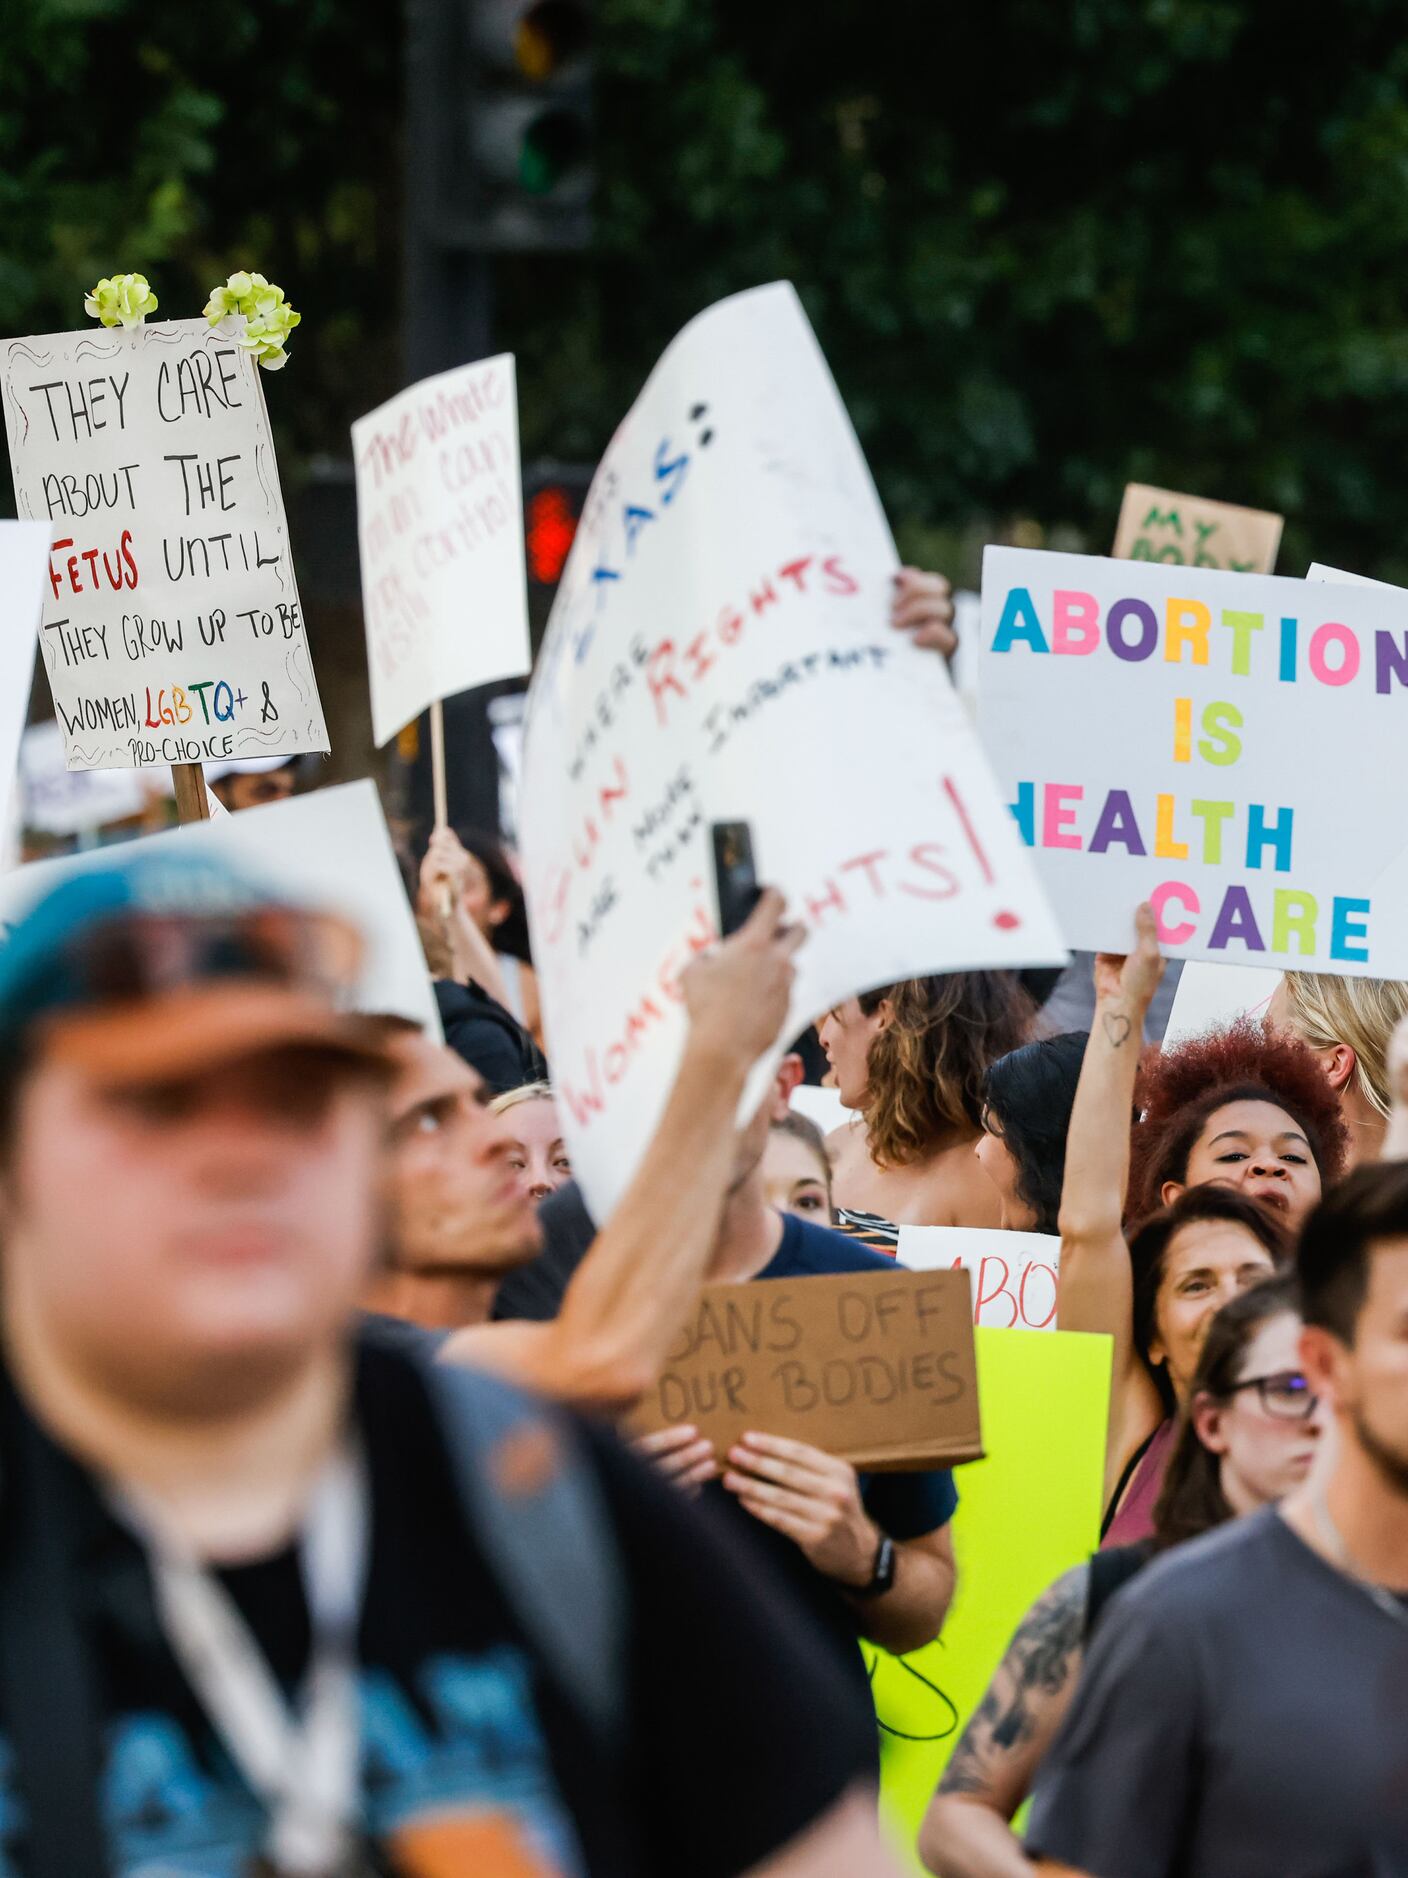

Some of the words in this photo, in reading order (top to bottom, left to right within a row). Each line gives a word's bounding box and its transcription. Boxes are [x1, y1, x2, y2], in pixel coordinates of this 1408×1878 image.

[28, 371, 130, 443] THEY
[157, 349, 243, 423] CARE
[42, 463, 140, 522] ABOUT
[163, 453, 242, 516] THE
[1142, 506, 1222, 552] MY
[49, 529, 139, 601] FETUS
[44, 618, 110, 667] THEY
[121, 613, 184, 661] GROW
[197, 608, 227, 646] UP
[235, 608, 274, 638] TO
[274, 602, 301, 640] BE
[645, 553, 862, 728] RIGHTS
[144, 679, 249, 729] LGBTQ+
[1173, 697, 1244, 766] IS
[127, 733, 235, 768] PRO-CHOICE
[800, 774, 1023, 934] HTS!
[1008, 781, 1295, 872] HEALTH
[1149, 880, 1371, 963] CARE
[837, 1284, 947, 1344] OFF
[658, 1365, 747, 1423] OUR
[771, 1350, 966, 1414] BODIES
